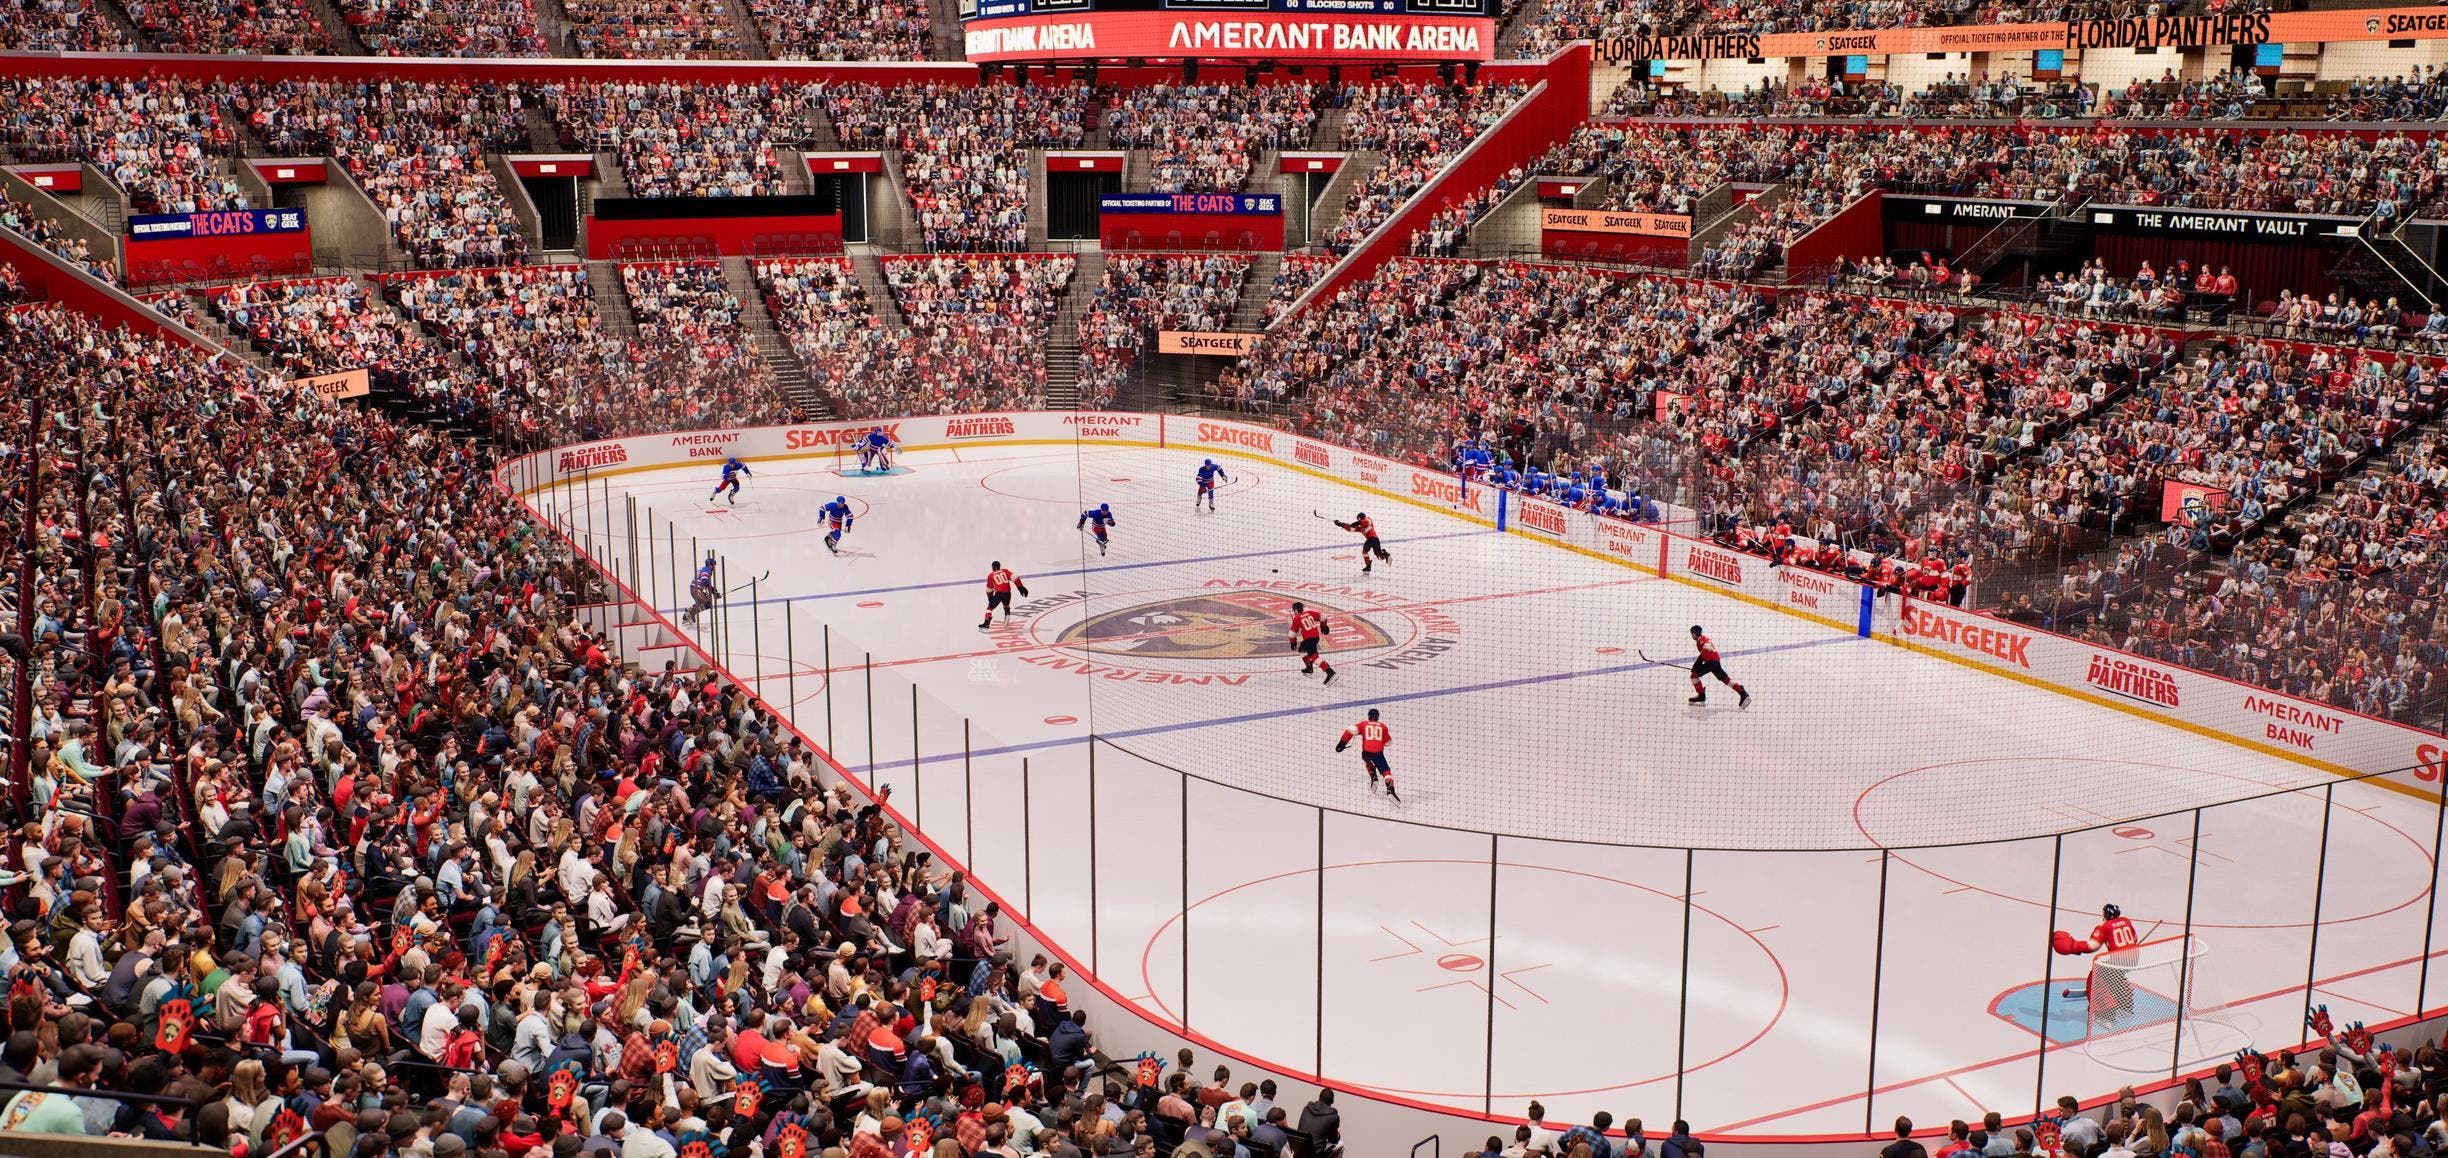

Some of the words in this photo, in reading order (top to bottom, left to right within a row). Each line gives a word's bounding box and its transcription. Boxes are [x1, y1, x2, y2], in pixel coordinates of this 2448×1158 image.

[1306, 0, 1346, 9] BLOCKED
[1347, 1, 1375, 9] SHOTS
[1383, 1, 1395, 10] 00
[2067, 19, 2149, 49] FLORIDA
[2155, 13, 2270, 46] PANTHERS
[2387, 14, 2448, 33] SEATGE
[1038, 23, 1096, 50] ARENA
[1169, 22, 1329, 49] AMERANT
[1333, 24, 1402, 50] BANK
[1406, 26, 1480, 51] ARENA
[1829, 35, 1876, 50] SEATGEEK
[1940, 34, 1970, 45] OFFICIAL
[1971, 32, 2006, 44] TICKETING
[2007, 31, 2038, 42] PARTNER
[2040, 31, 2049, 41] OF
[2050, 30, 2065, 41] THE
[1594, 37, 1663, 61] FLORIDA
[1668, 34, 1761, 59] PANTHERS
[1171, 195, 1194, 211] THE
[1198, 195, 1235, 212] CATS
[1953, 204, 2016, 219] AMERANT
[190, 214, 209, 236] THE
[210, 212, 254, 234] CATS
[281, 213, 298, 221] SEAT
[281, 220, 299, 228] GEEK
[1547, 213, 1588, 226] SEATGEEK
[1604, 216, 1642, 229] SEATGEEK
[1654, 218, 1687, 232] SEATGEEK
[2136, 213, 2162, 228] THE
[2169, 215, 2249, 233] AMERANT
[2256, 219, 2308, 236] VAULT
[1180, 336, 1243, 350] SEATGEEK
[949, 417, 1011, 425] FLORIDA
[1063, 416, 1142, 426] AMERANT
[946, 423, 1015, 438] PANTHERS
[1082, 427, 1119, 437] BANK
[1198, 422, 1274, 453] SEATGEEK
[672, 433, 740, 446] AMERANT
[1296, 441, 1328, 454] FLORIDA
[561, 443, 623, 458] FLORIDA
[689, 446, 722, 457] BANK
[1294, 446, 1330, 468] PANTHERS
[559, 450, 628, 473] PANTHERS
[1352, 456, 1388, 474] AMERANT
[1361, 472, 1378, 484] BANK
[1522, 501, 1564, 518] FLORIDA
[1519, 507, 1567, 536] PANTHERS
[1598, 521, 1646, 543] AMERANT
[1608, 540, 1632, 557] BANK
[1690, 546, 1738, 566] FLORIDA
[993, 572, 1008, 585] 00
[1687, 555, 1742, 585] PANTHERS
[1778, 570, 1834, 595] AMERANT
[1791, 590, 1818, 609] BANK
[1202, 579, 1409, 601] AMERANT
[1361, 636, 1457, 670] ARENA
[1301, 615, 1317, 631] 00
[1902, 604, 2032, 670] SEATGEEK
[1017, 655, 1250, 686] AMERANT
[2092, 654, 2174, 684] FLORIDA
[2086, 662, 2180, 708] PANTHERS
[2244, 695, 2344, 735] AMERANT
[1365, 725, 1382, 741] 00
[2266, 724, 2314, 750] BANK
[2113, 926, 2135, 947] 00
